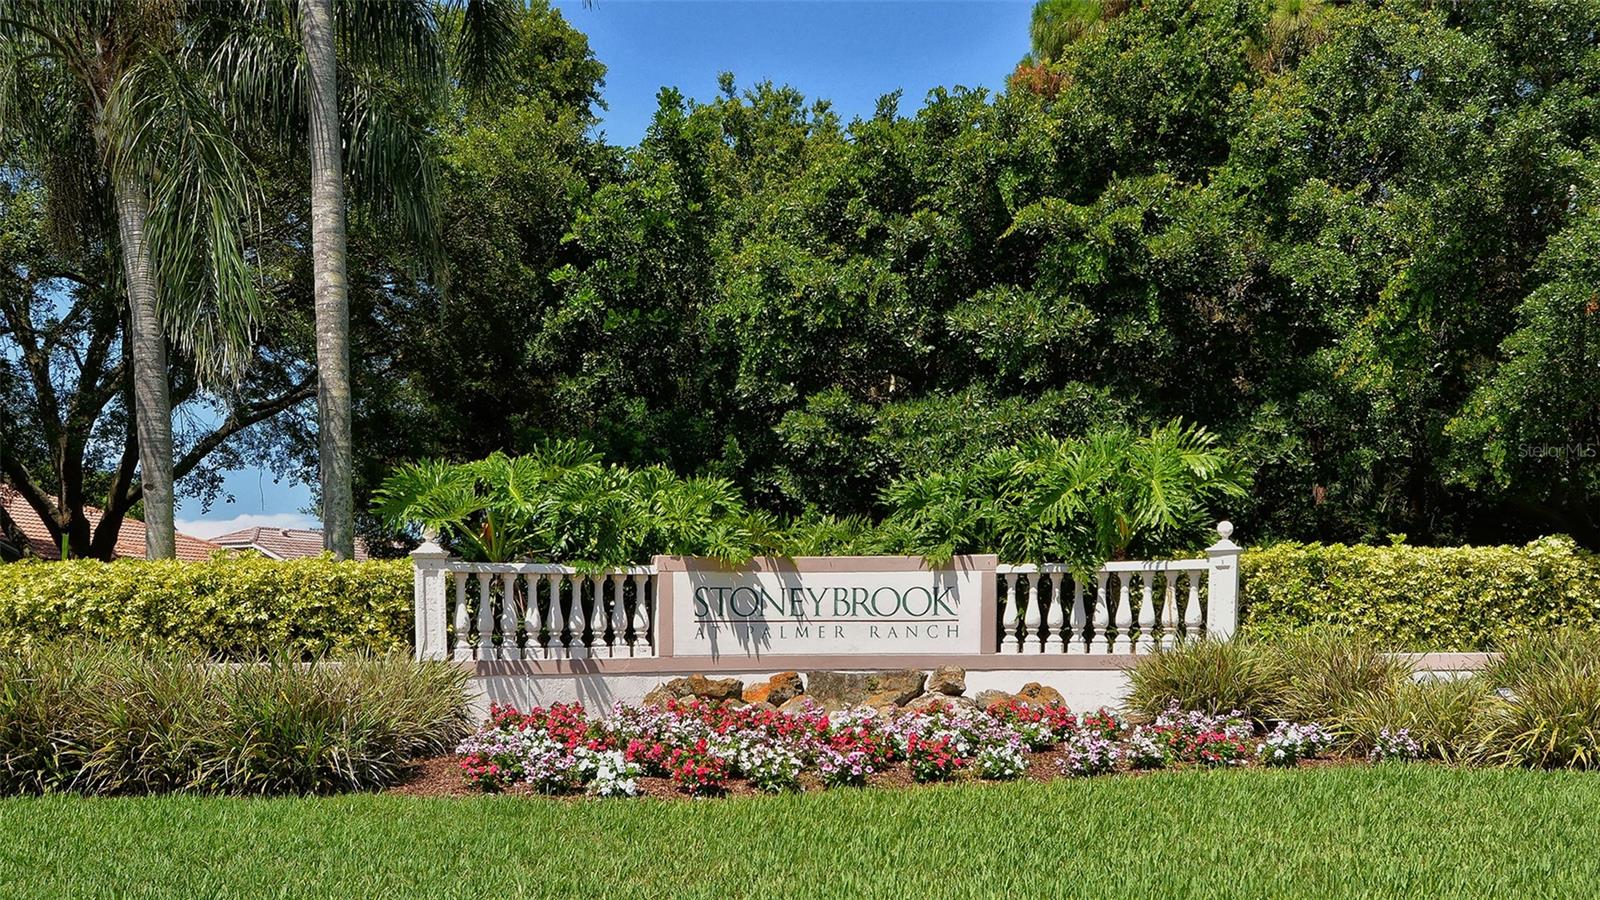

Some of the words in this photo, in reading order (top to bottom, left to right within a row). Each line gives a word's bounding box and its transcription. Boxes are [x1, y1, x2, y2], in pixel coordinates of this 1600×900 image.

[694, 586, 958, 618] STONEYBROOK
[694, 625, 721, 640] AT
[746, 625, 845, 640] PALMER
[869, 624, 959, 639] RANCH
